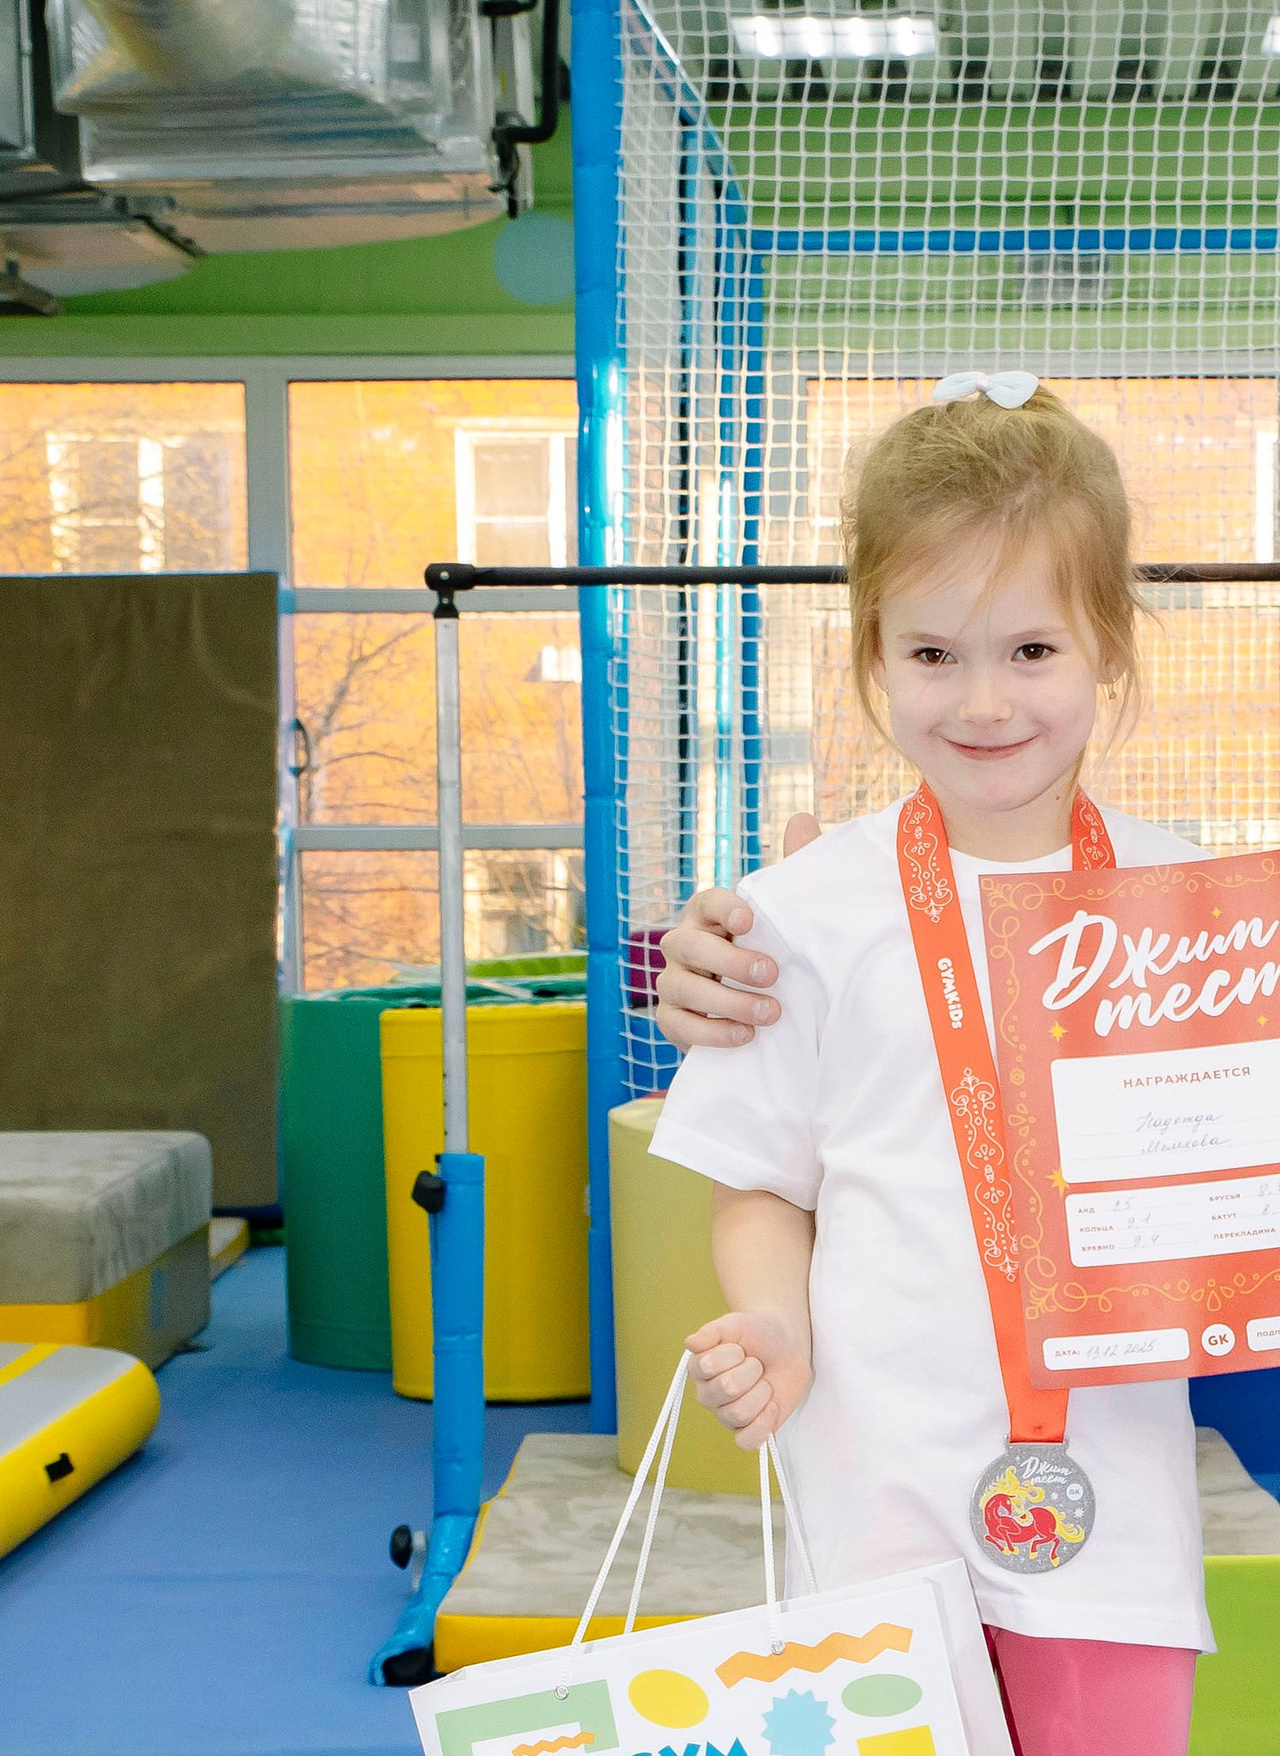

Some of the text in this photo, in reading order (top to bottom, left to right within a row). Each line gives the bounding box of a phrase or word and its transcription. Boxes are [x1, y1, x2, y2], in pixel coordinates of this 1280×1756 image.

[1028, 910, 1280, 1011] Джим
[1123, 1066, 1252, 1089] НАГРАЖДАЕТСЯ
[1209, 1193, 1241, 1202] БРУСЬЯ
[1211, 1213, 1237, 1221] БАТУТ
[1079, 1225, 1114, 1233] КОЛЬЦА
[1213, 1227, 1276, 1240] ПЕРЕКЛАДИНА
[1081, 1244, 1115, 1252] БРЕВНО
[1208, 1333, 1229, 1346] GK
[1055, 1349, 1080, 1357] ДАТА:
